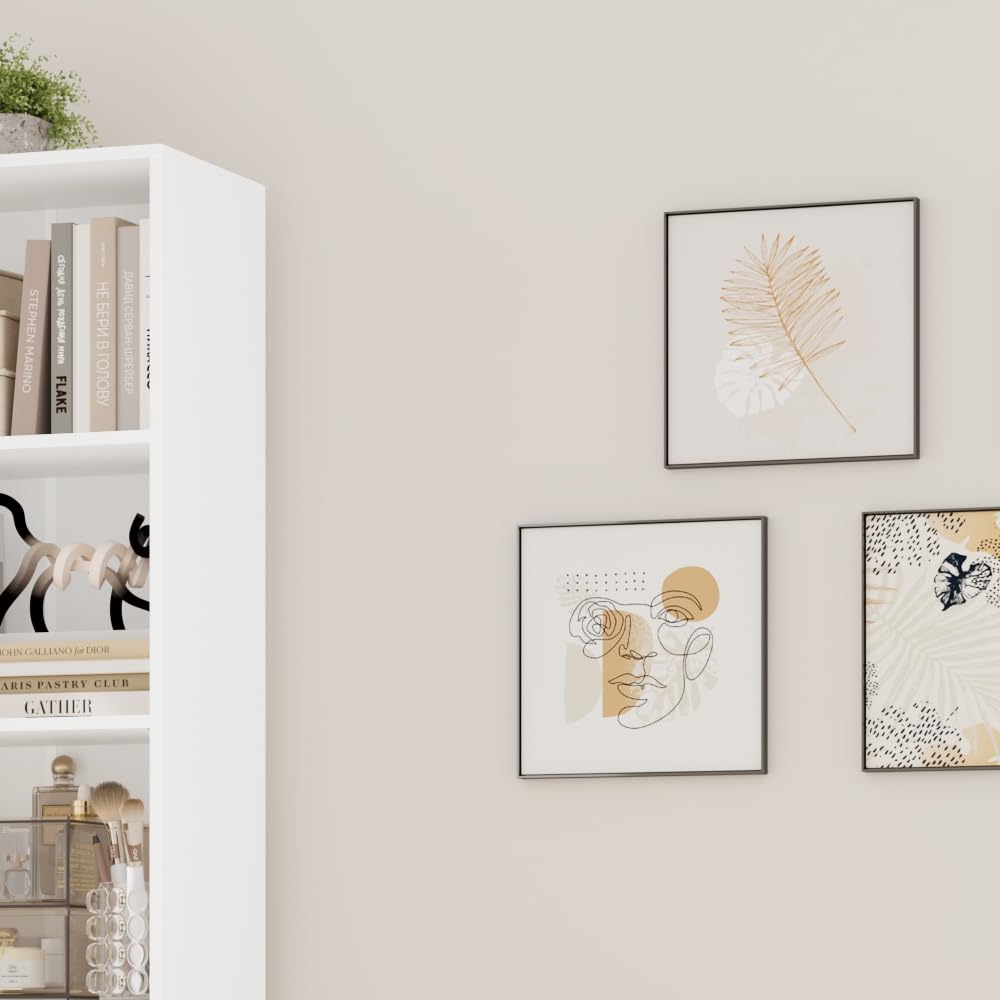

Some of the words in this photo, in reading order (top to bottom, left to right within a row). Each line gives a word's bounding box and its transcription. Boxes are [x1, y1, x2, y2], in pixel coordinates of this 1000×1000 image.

[96, 281, 109, 298] НЕ
[25, 289, 39, 344] STEPHEN
[96, 303, 109, 337] БЕРИ
[96, 341, 109, 350] В
[22, 346, 37, 393] MARINO
[96, 353, 109, 407] ГОЛОВУ
[56, 375, 67, 414] FLAKE
[24, 647, 73, 656] GALLIANO
[74, 647, 84, 656] for
[85, 645, 110, 655] DIOR
[37, 680, 88, 690] PASTRY
[94, 679, 130, 689] CLUB
[24, 699, 93, 715] GATHER
